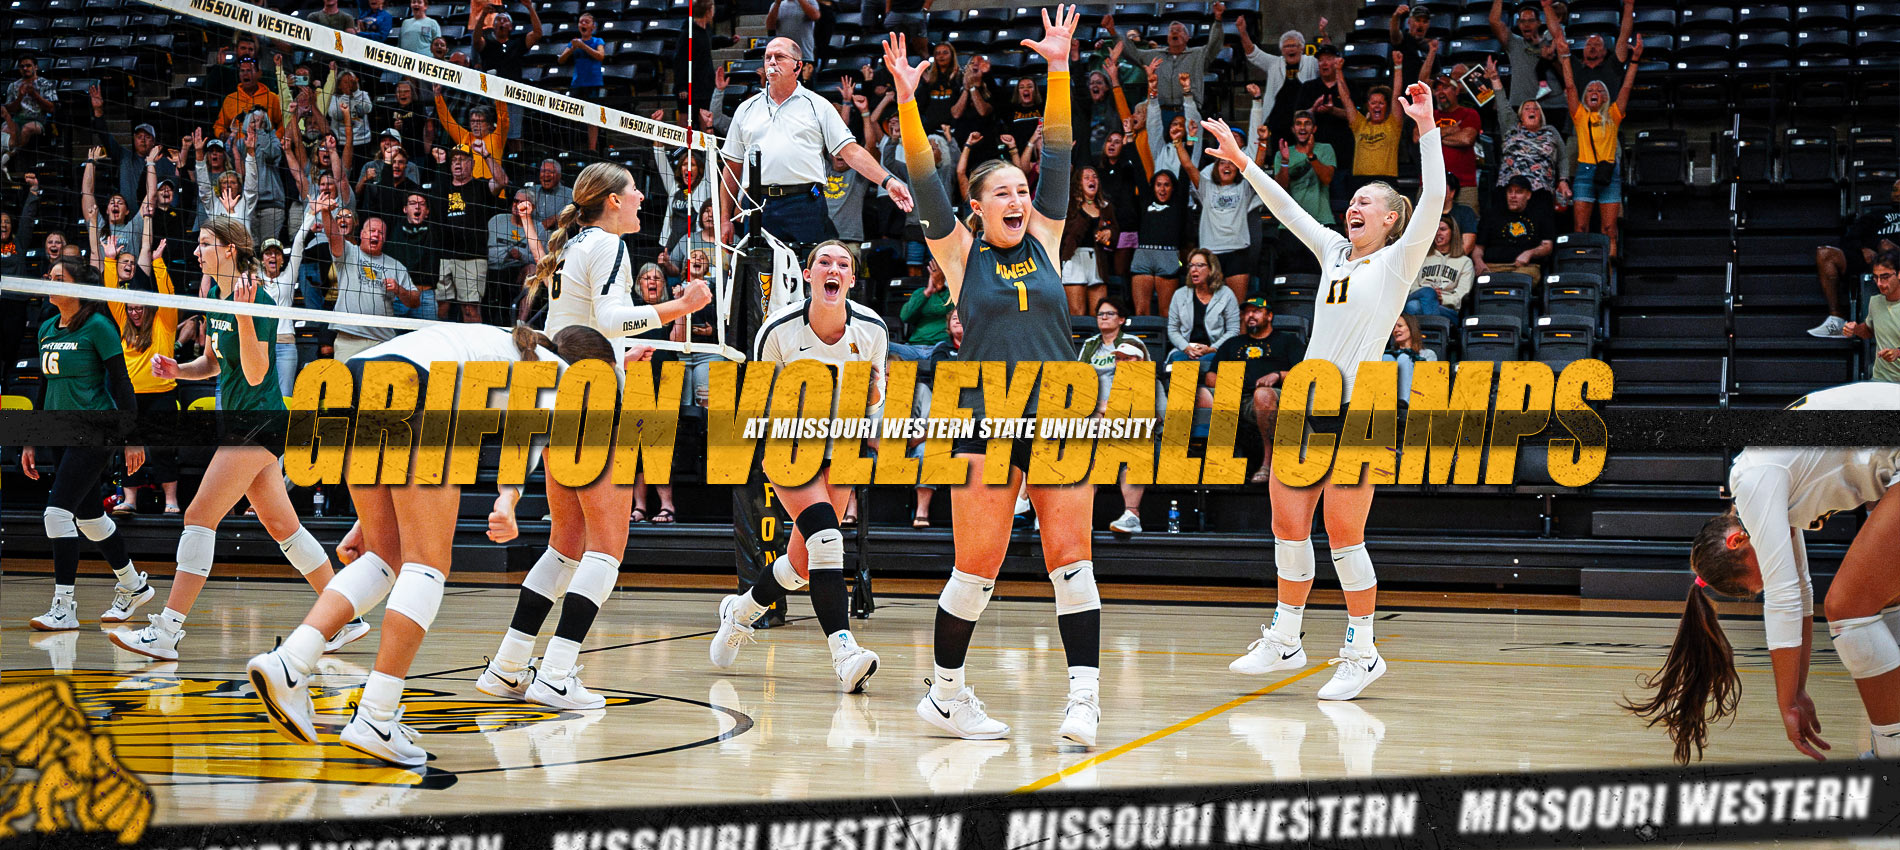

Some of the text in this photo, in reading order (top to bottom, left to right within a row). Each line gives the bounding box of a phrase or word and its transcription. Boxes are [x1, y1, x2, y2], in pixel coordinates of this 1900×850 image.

[190, 0, 313, 42] MISSOURI WESTERN
[364, 45, 462, 84] MISSOURI WESTERN
[504, 84, 584, 117] MISSOURI WESTERN
[619, 116, 685, 143] MISSOURI WESTERN
[1421, 263, 1459, 284] SOUTHERN
[1013, 280, 1028, 311] 1
[1326, 275, 1350, 304] 11
[623, 318, 648, 331] MWSU
[42, 351, 60, 374] 16
